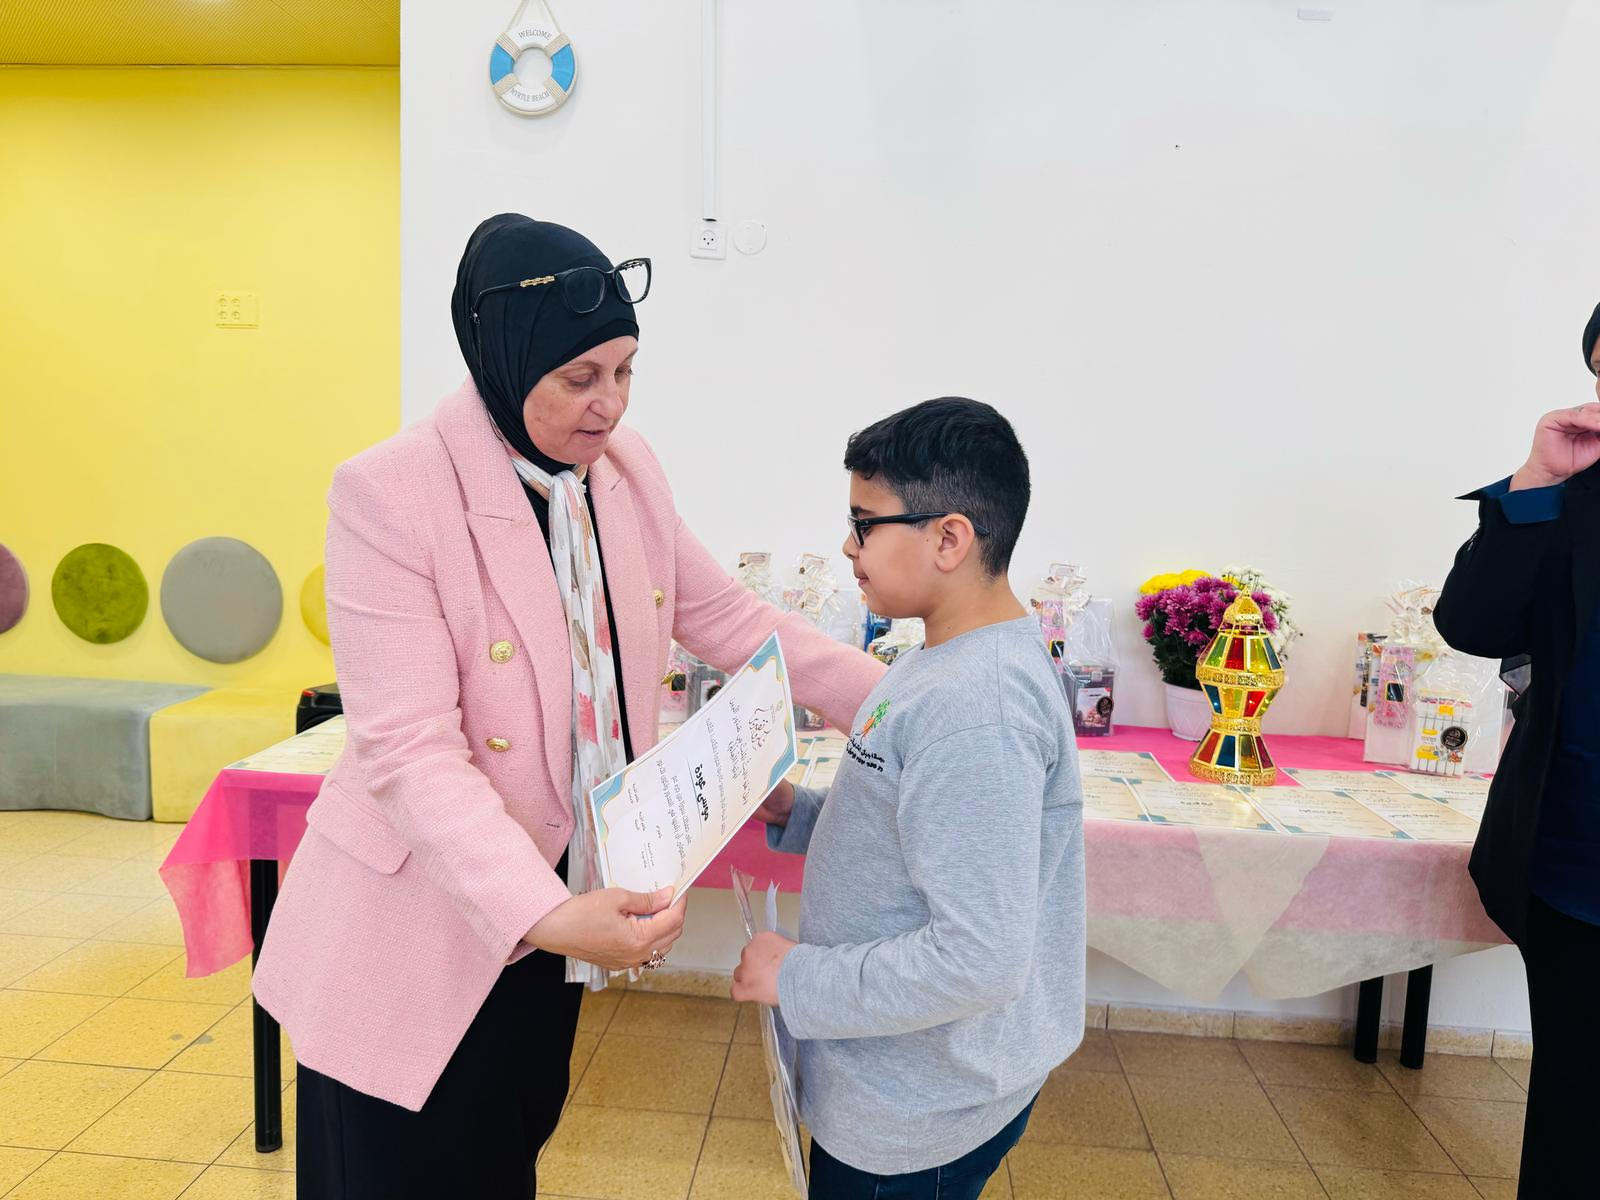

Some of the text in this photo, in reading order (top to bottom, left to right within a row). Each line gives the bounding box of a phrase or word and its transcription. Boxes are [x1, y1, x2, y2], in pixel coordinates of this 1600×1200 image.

[518, 29, 552, 40] WELCOME
[511, 88, 550, 101] MYRTLE BEACH
[695, 764, 709, 822] موسى عودة
